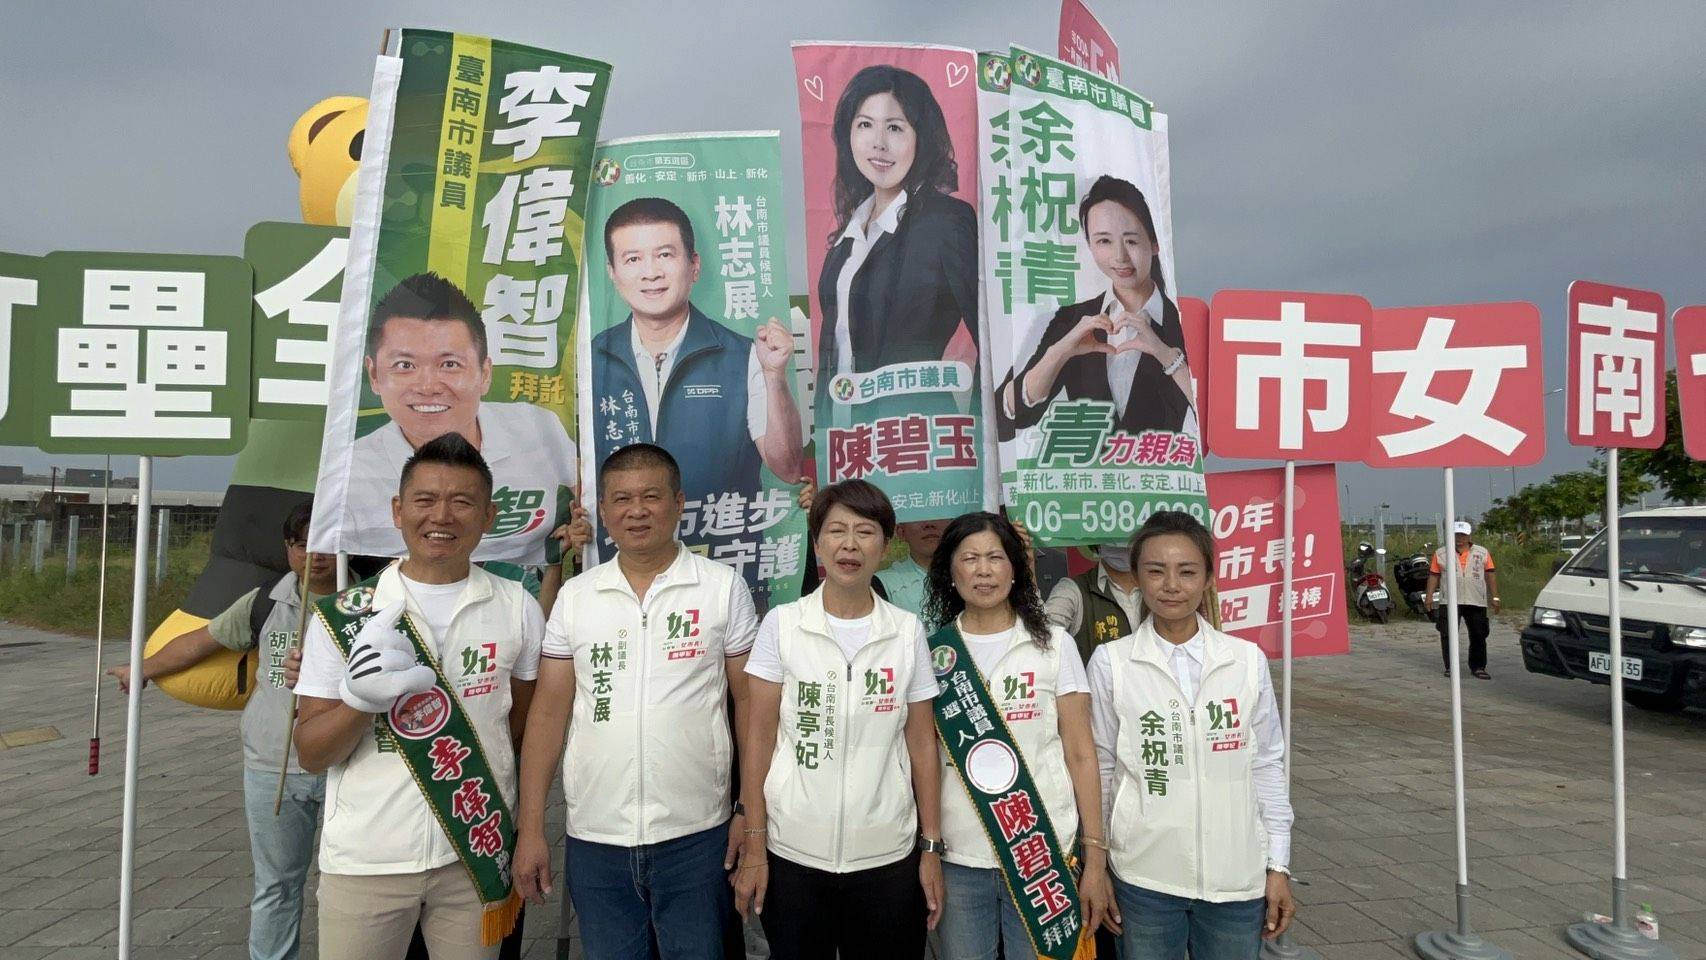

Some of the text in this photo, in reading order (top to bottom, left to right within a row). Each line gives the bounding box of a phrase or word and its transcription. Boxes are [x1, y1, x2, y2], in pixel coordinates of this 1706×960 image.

[440, 54, 486, 211] 臺南市議員
[1046, 66, 1147, 124] 臺南市議員
[480, 65, 597, 369] 李偉智
[756, 195, 774, 298] 台南市議員候選人
[1018, 100, 1081, 307] 余祝青
[714, 195, 760, 320] 林志展
[50, 268, 231, 439] 壘
[509, 371, 566, 404] 拜託
[859, 366, 960, 399] 台南市議員
[1223, 302, 1361, 450] 市
[1372, 317, 1528, 458] 女
[1578, 296, 1658, 438] 南
[828, 414, 978, 484] 陳碧玉
[1039, 402, 1198, 467] 青力親為
[750, 583, 789, 593] GRESS
[590, 642, 613, 723] 林志展
[796, 681, 821, 769] 陳亭妃
[823, 683, 836, 760] 台南市長候選人
[951, 671, 995, 737] 台南市議員
[1139, 710, 1169, 796] 余祝青
[1171, 712, 1184, 766] 台南市議員
[989, 789, 1072, 926] 陳碧玉
[1042, 909, 1078, 952] 拜託
